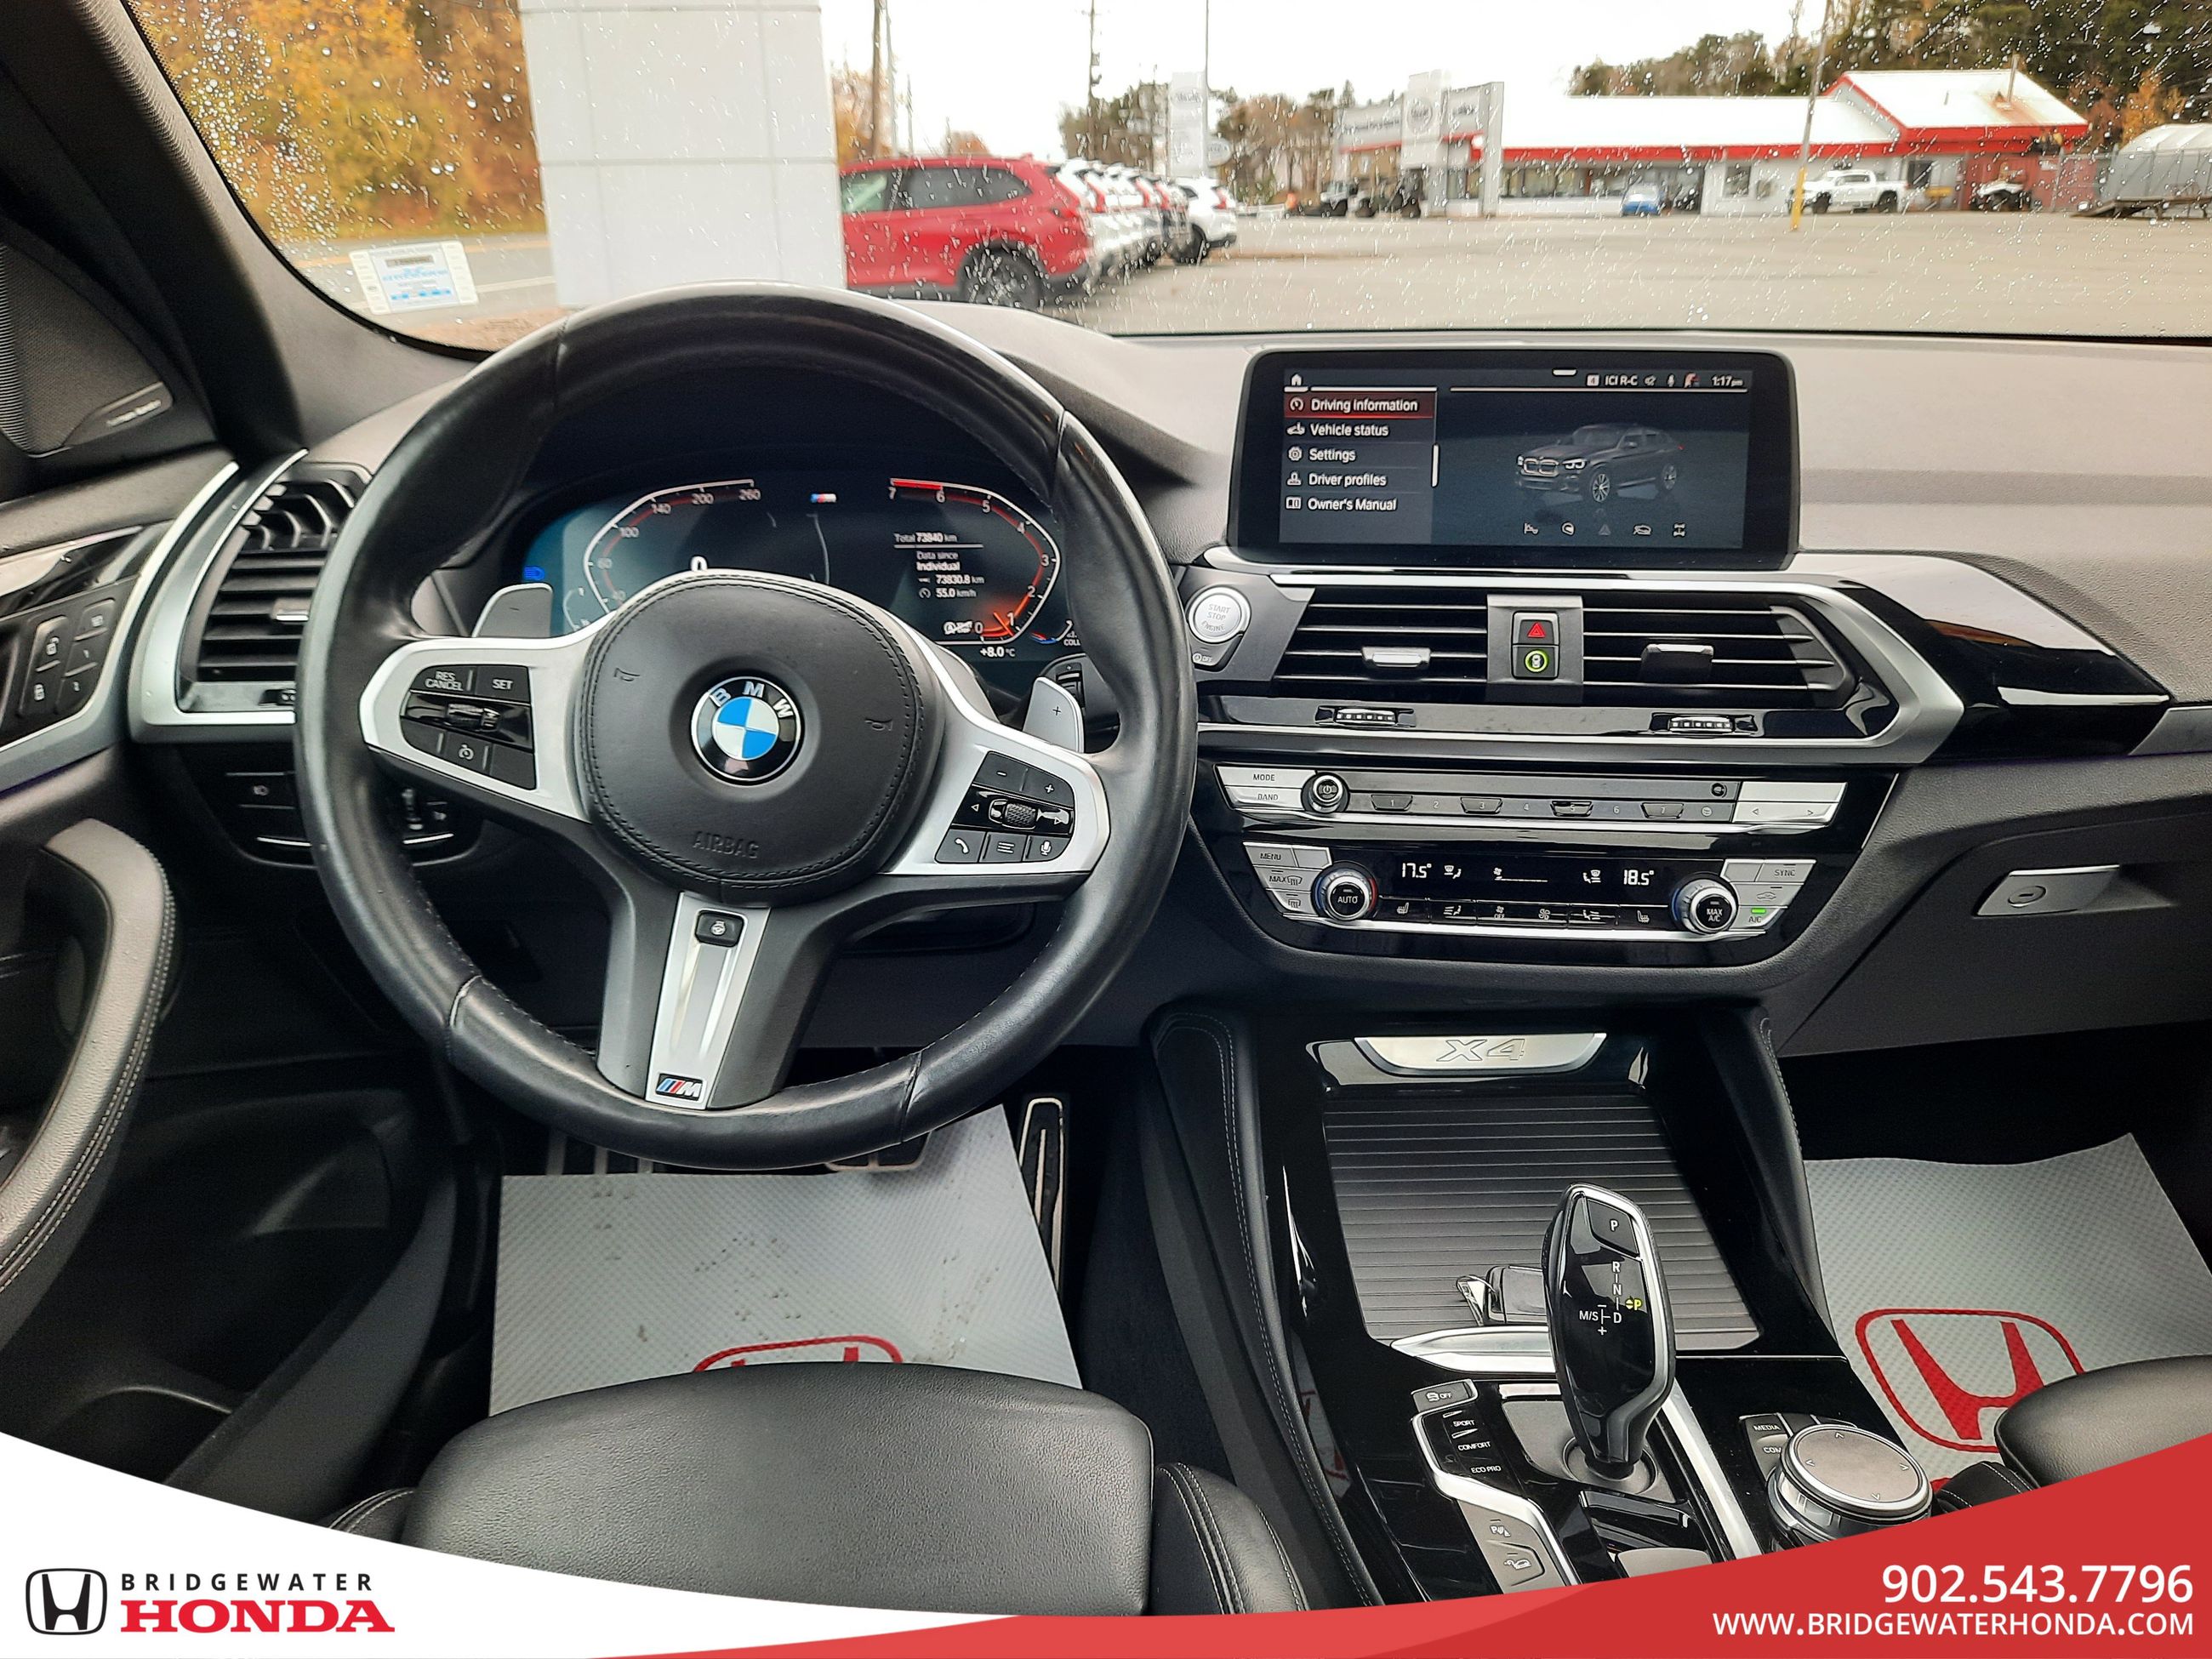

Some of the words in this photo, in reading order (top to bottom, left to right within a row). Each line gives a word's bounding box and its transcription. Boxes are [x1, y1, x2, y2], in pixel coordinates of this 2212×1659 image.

[1311, 399, 1351, 413] Driving
[1310, 424, 1352, 436] Vehicle
[1354, 425, 1389, 436] status
[1308, 448, 1356, 463] Settings
[1308, 473, 1342, 486] Driver
[1344, 472, 1387, 487] profiles
[889, 487, 897, 499] 7
[937, 490, 945, 503] 6
[692, 493, 714, 505] 200
[1308, 498, 1354, 510] Owner's
[1355, 499, 1397, 510] Manual
[983, 500, 990, 513] 5
[1017, 522, 1025, 533] 4
[916, 550, 936, 560] Data
[937, 551, 959, 560] since
[1040, 554, 1050, 566] 3
[916, 561, 961, 572] Individual
[936, 587, 955, 598] 55.0
[1027, 585, 1035, 597] 2
[1208, 603, 1231, 615] START
[1007, 613, 1015, 625] 1
[1207, 612, 1227, 622] STOP
[974, 622, 983, 633] 0
[1201, 620, 1226, 633] ENGINE
[979, 647, 1005, 658] +8.0
[435, 670, 456, 681] RES
[425, 678, 464, 692] CANCEL
[492, 679, 513, 690] SET
[710, 681, 794, 720] BMW
[1252, 772, 1276, 783] MODE
[1389, 799, 1395, 807] 1
[1433, 800, 1440, 808] 2
[1479, 801, 1485, 810] 3
[1613, 806, 1620, 814] 6
[1259, 852, 1282, 862] MENU
[1774, 869, 1796, 877] SYNC
[1268, 874, 1286, 884] MAX
[1337, 895, 1359, 904] AUTO
[1707, 908, 1723, 916] MAX
[1707, 915, 1720, 923] A/C
[1435, 1038, 1526, 1062] X4
[1610, 1219, 1618, 1231] P
[1612, 1261, 1621, 1273] R
[1612, 1284, 1622, 1296] N
[1634, 1299, 1642, 1311] P
[1579, 1310, 1599, 1321] M/S
[1613, 1312, 1622, 1324] D
[1753, 1423, 1781, 1432] MEDIA
[1457, 1441, 1491, 1451] COMFORT
